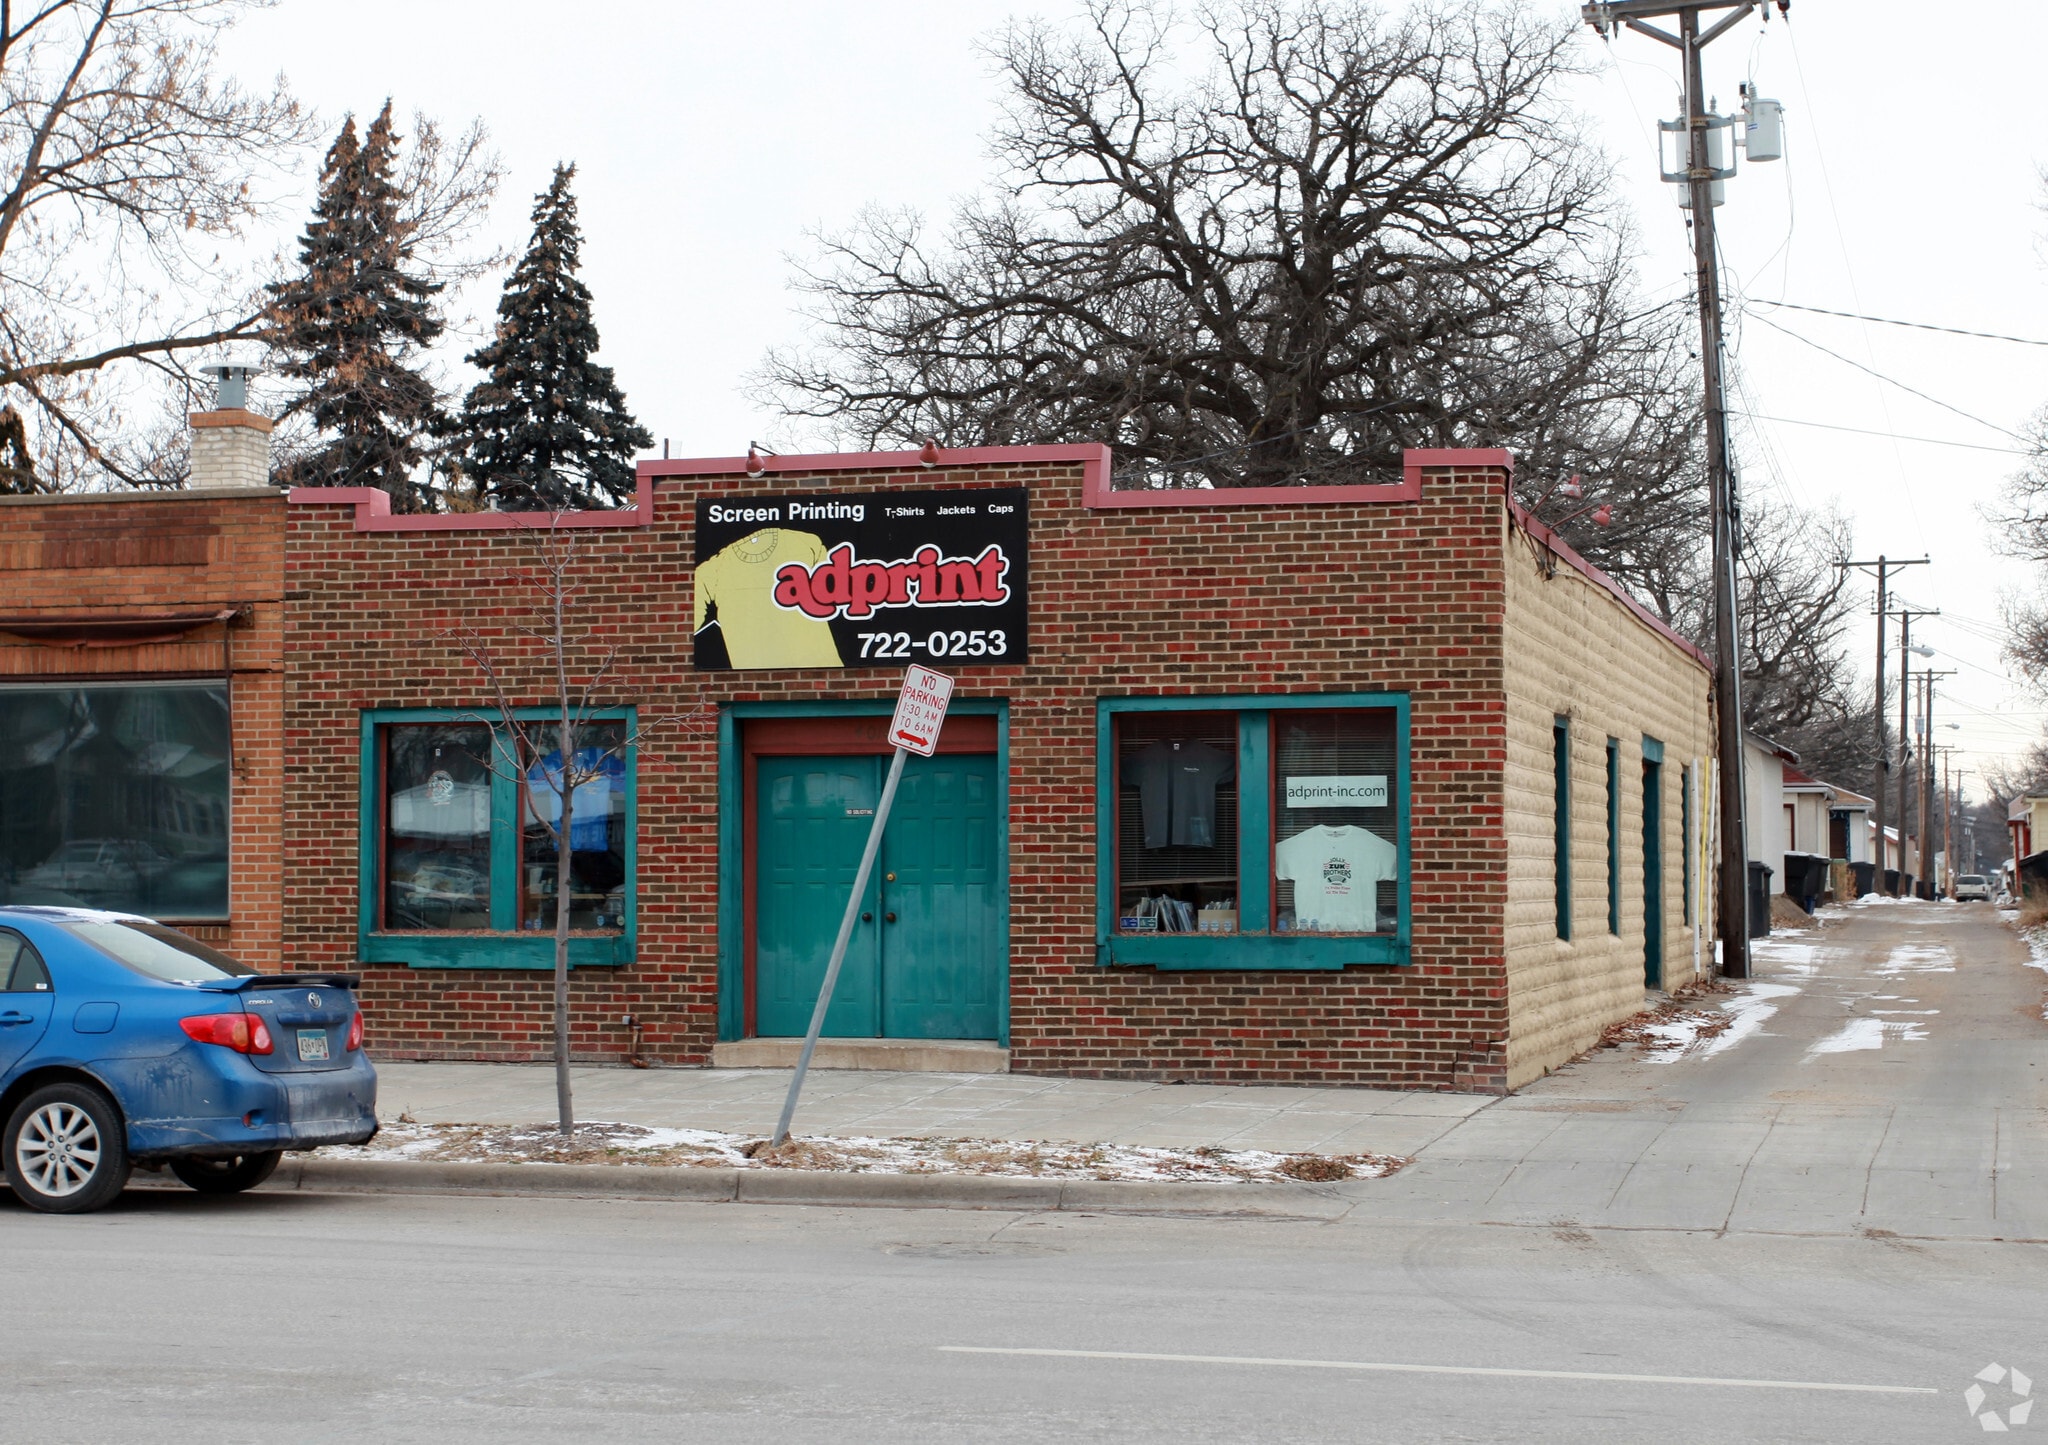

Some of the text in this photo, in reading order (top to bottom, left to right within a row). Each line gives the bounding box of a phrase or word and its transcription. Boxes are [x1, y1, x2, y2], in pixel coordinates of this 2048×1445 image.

[708, 502, 865, 523] Screen Printing
[885, 504, 1014, 517] T-Shirts Jackets Caps
[772, 542, 1009, 620] adprint
[857, 630, 1007, 658] 722-0253
[920, 675, 937, 690] NO
[904, 686, 945, 710] PARKING
[903, 702, 938, 722] 1:30 AM
[900, 716, 911, 728] TO
[1287, 785, 1385, 800] adprint-inc.com
[1323, 869, 1351, 879] BROTHERS
